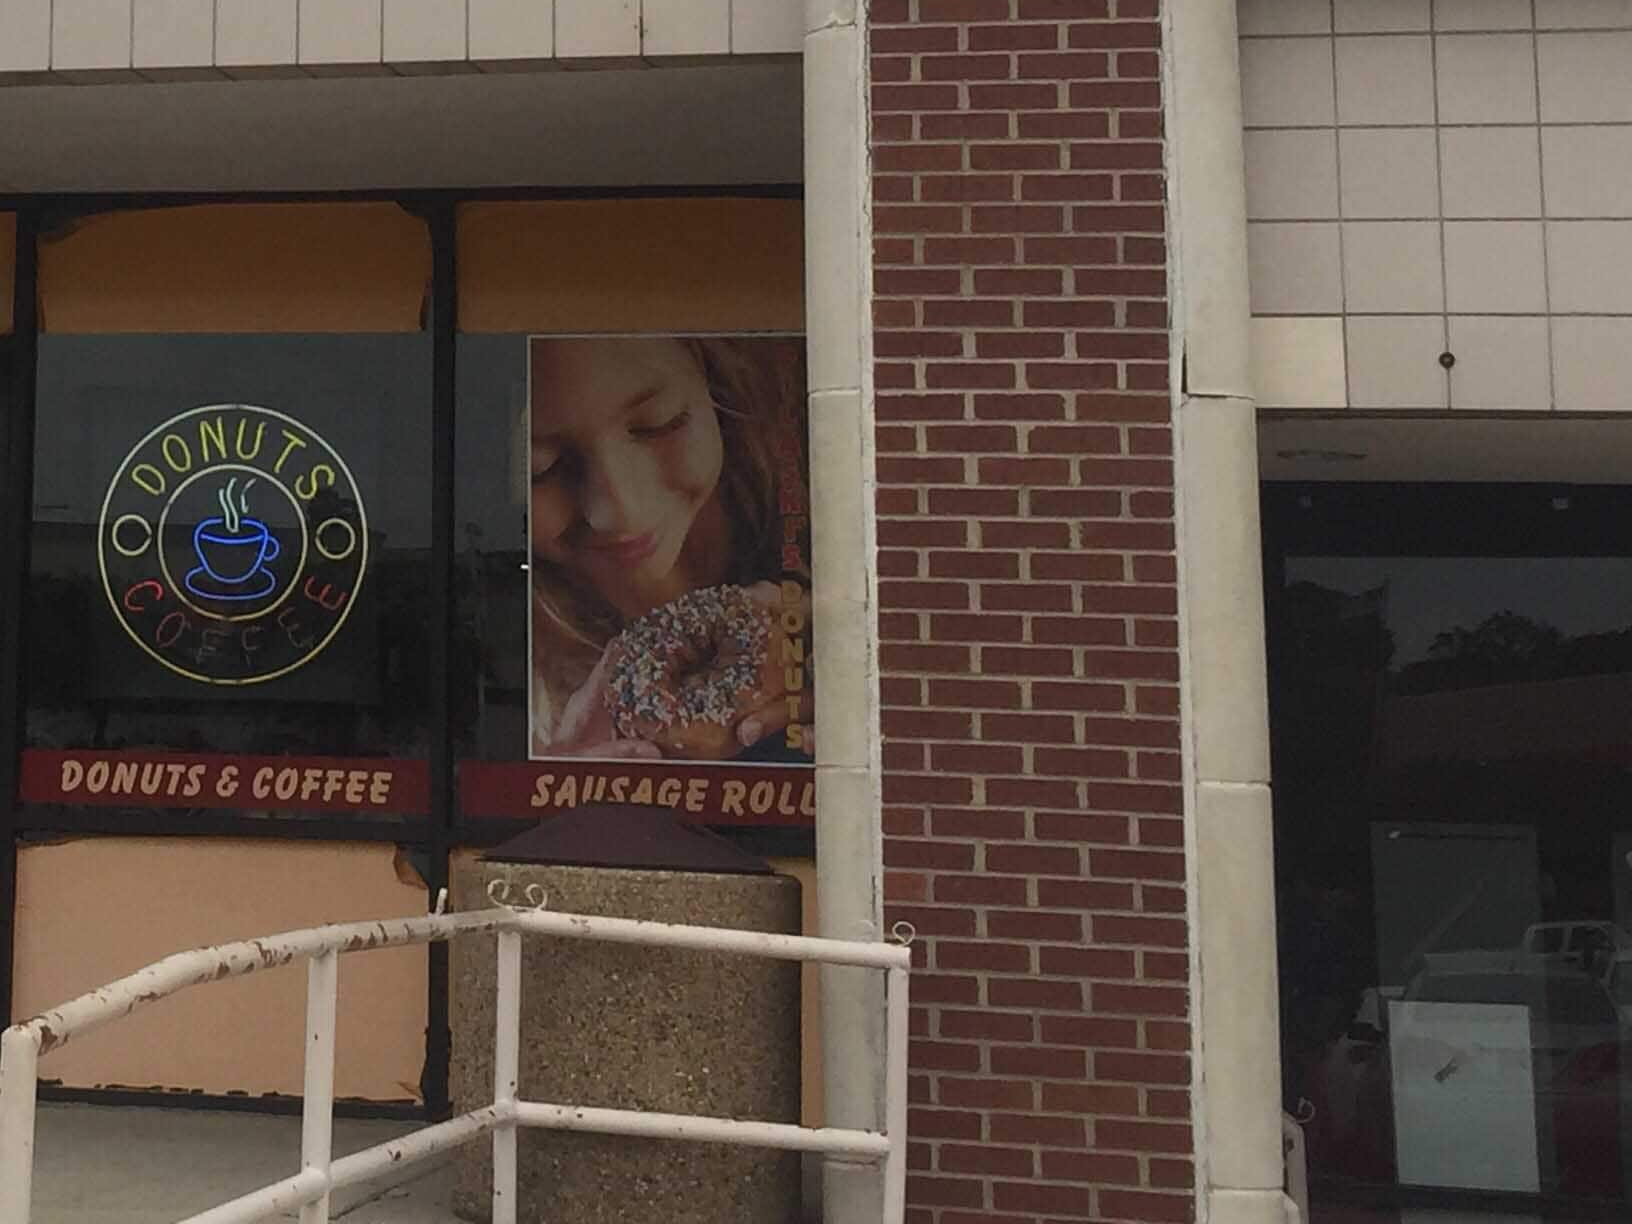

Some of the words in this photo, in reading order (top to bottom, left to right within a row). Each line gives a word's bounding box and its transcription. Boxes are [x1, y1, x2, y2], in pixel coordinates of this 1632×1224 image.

[132, 416, 335, 500] DONUTS
[61, 760, 206, 798] DONUTS
[215, 765, 240, 798] &
[251, 766, 393, 804] COFFEE
[530, 774, 710, 813] SAUSAGE
[721, 780, 817, 817] ROLL
